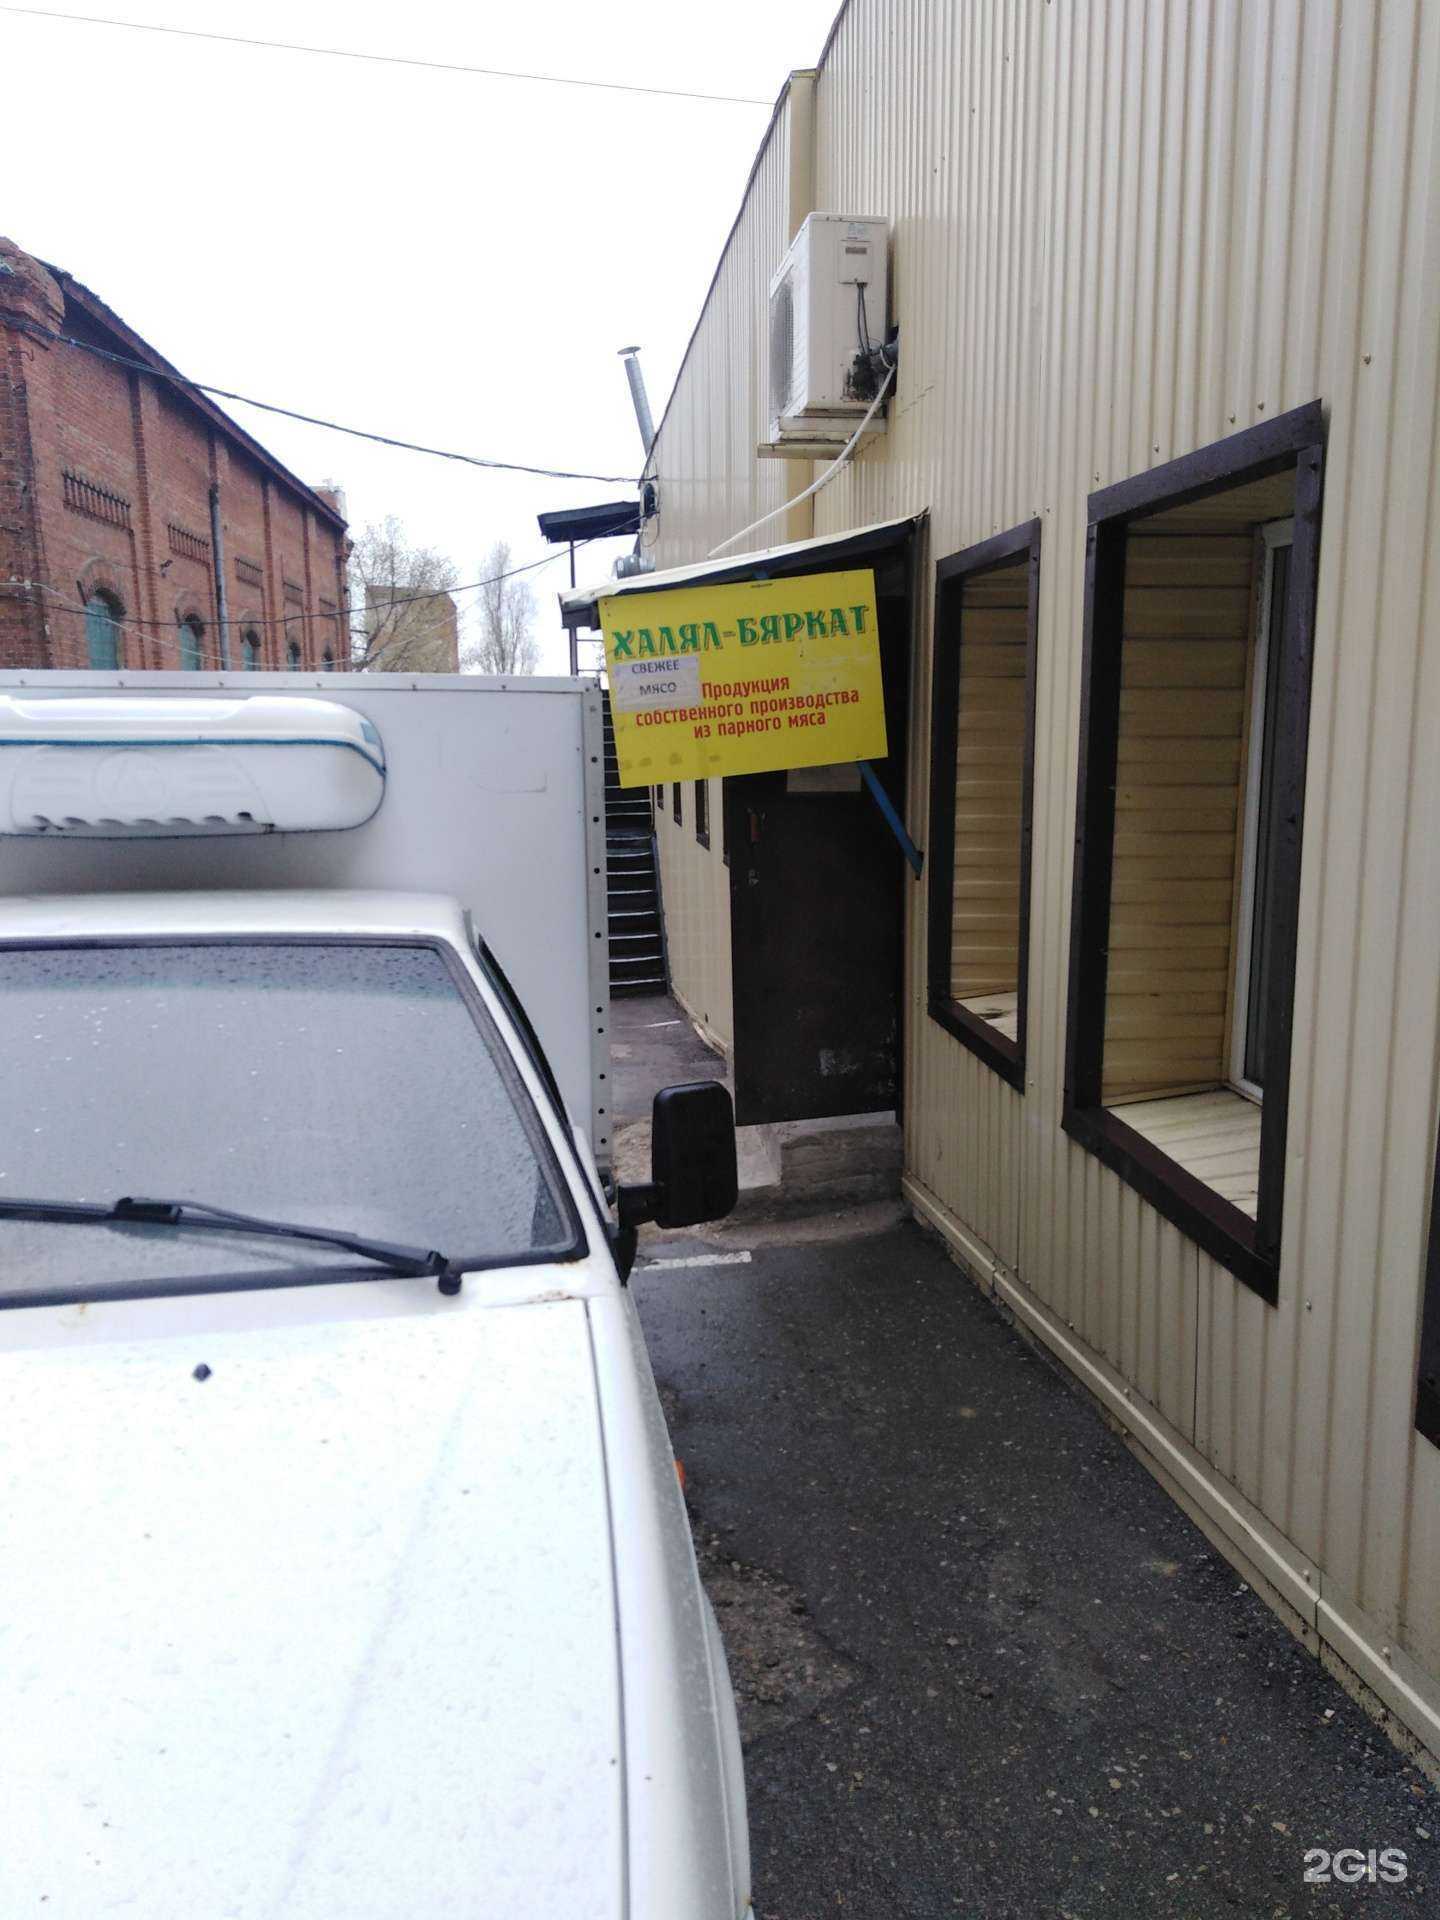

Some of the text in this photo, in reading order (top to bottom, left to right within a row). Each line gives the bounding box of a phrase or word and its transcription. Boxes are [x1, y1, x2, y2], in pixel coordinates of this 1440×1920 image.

[612, 605, 870, 659] ХАЛЯЛ-БЯРКАТ
[631, 659, 680, 675] СВЕЖЕЕ
[701, 676, 790, 700] Продукция
[636, 689, 860, 728] собственного производства
[694, 711, 826, 739] из парного мяса
